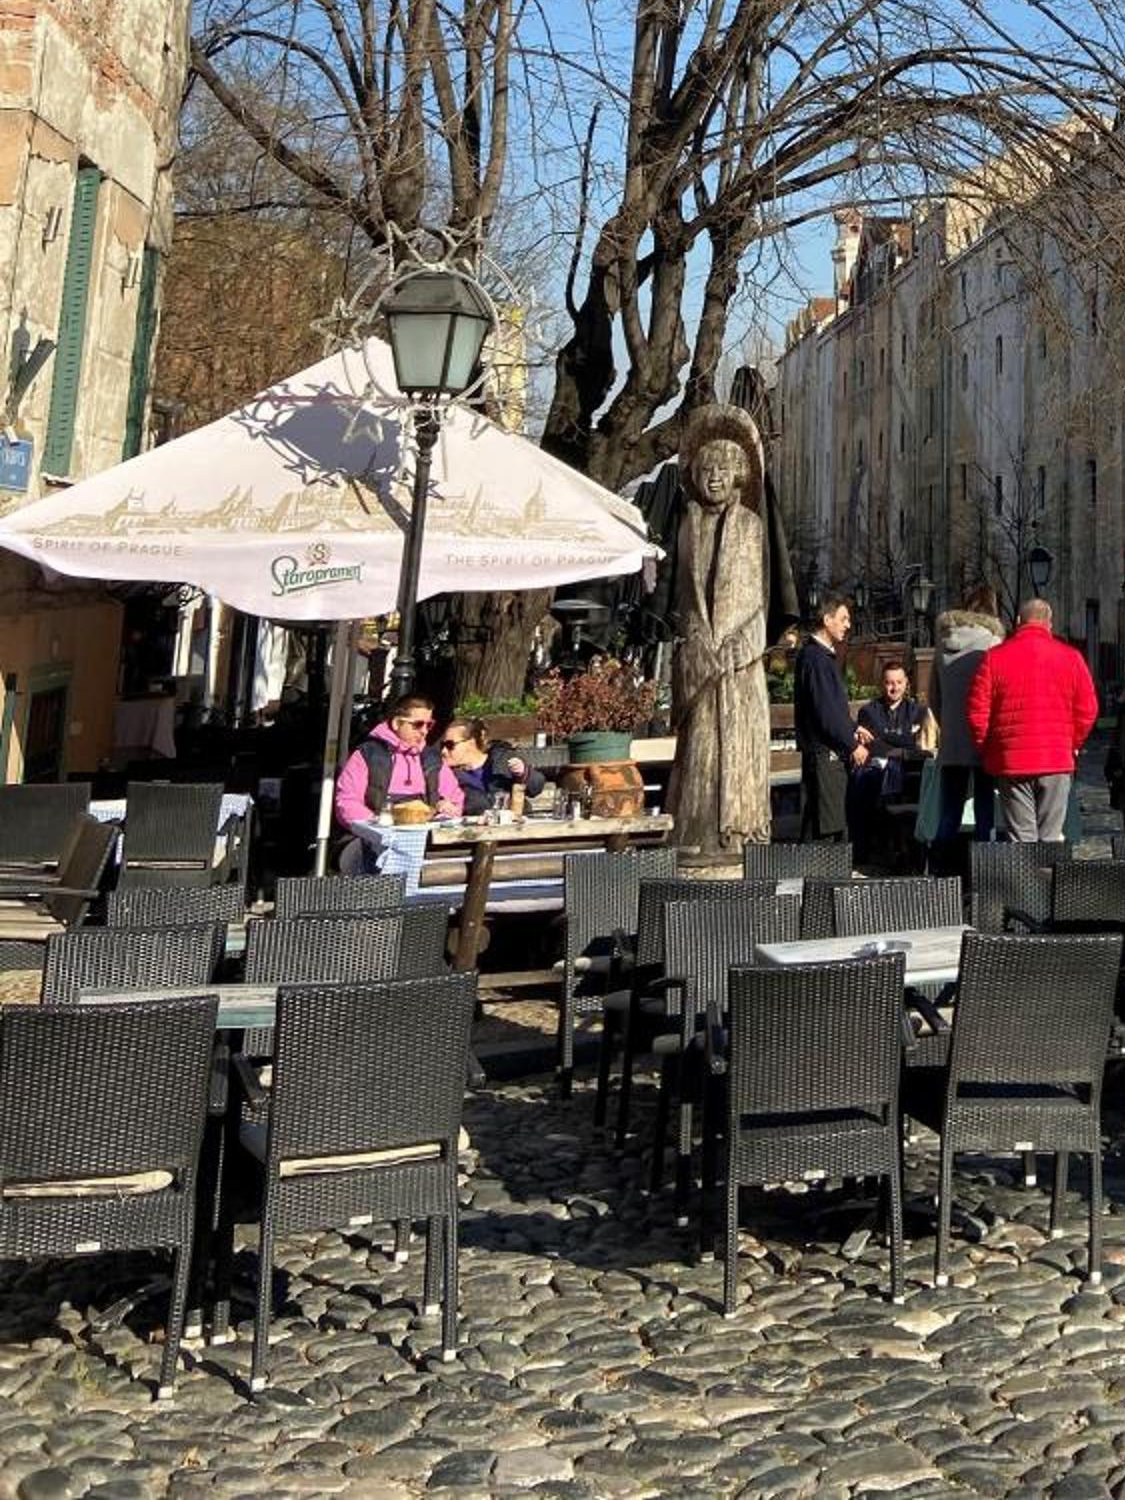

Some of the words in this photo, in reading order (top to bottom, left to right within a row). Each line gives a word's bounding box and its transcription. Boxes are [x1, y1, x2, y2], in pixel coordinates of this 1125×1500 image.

[32, 537, 82, 550] SPIRIT
[89, 541, 111, 553] OF
[117, 541, 184, 557] PRAGUE
[446, 554, 473, 566] THE
[479, 555, 525, 567] SPIRIT
[531, 555, 551, 568] OF
[271, 555, 362, 597] Staropramen
